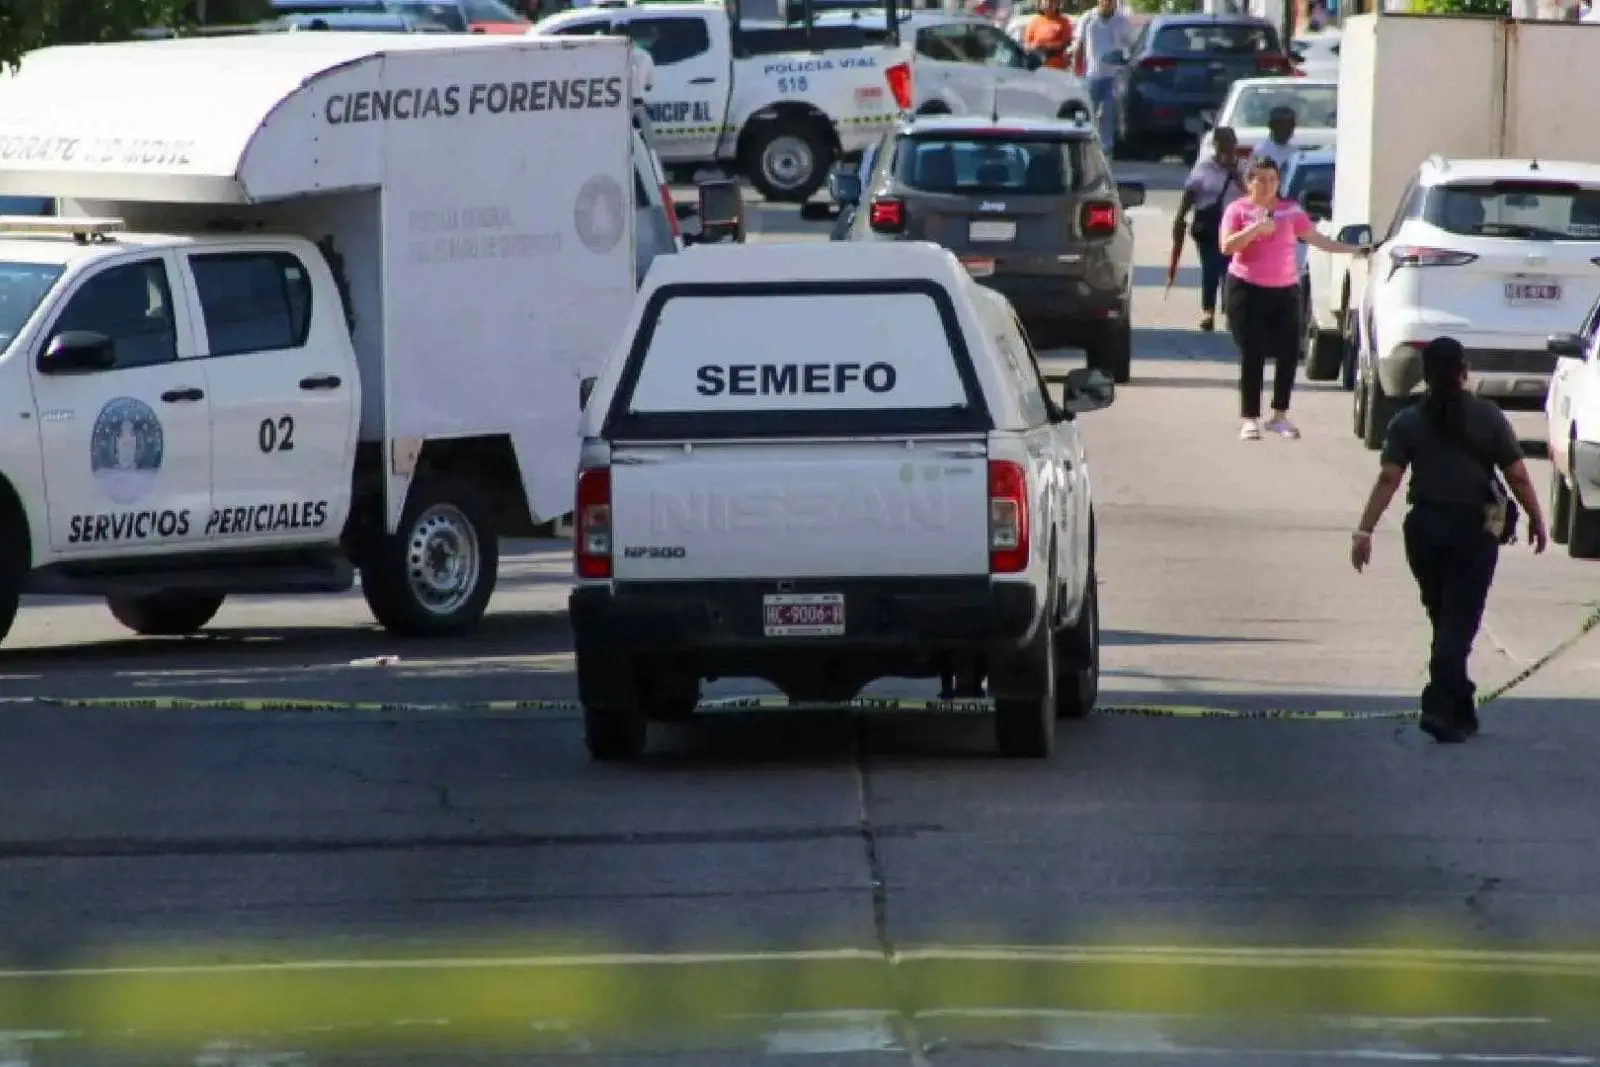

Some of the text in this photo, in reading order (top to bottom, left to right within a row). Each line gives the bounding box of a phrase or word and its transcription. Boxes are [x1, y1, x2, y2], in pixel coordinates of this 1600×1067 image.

[763, 59, 834, 75] POLICIA
[326, 77, 622, 125] CIENCIAS FORENSES
[696, 361, 897, 396] SEMEFO
[258, 414, 295, 454] 02
[68, 500, 329, 544] SERVICIOS PERICIALES
[649, 483, 949, 535] NISSAN
